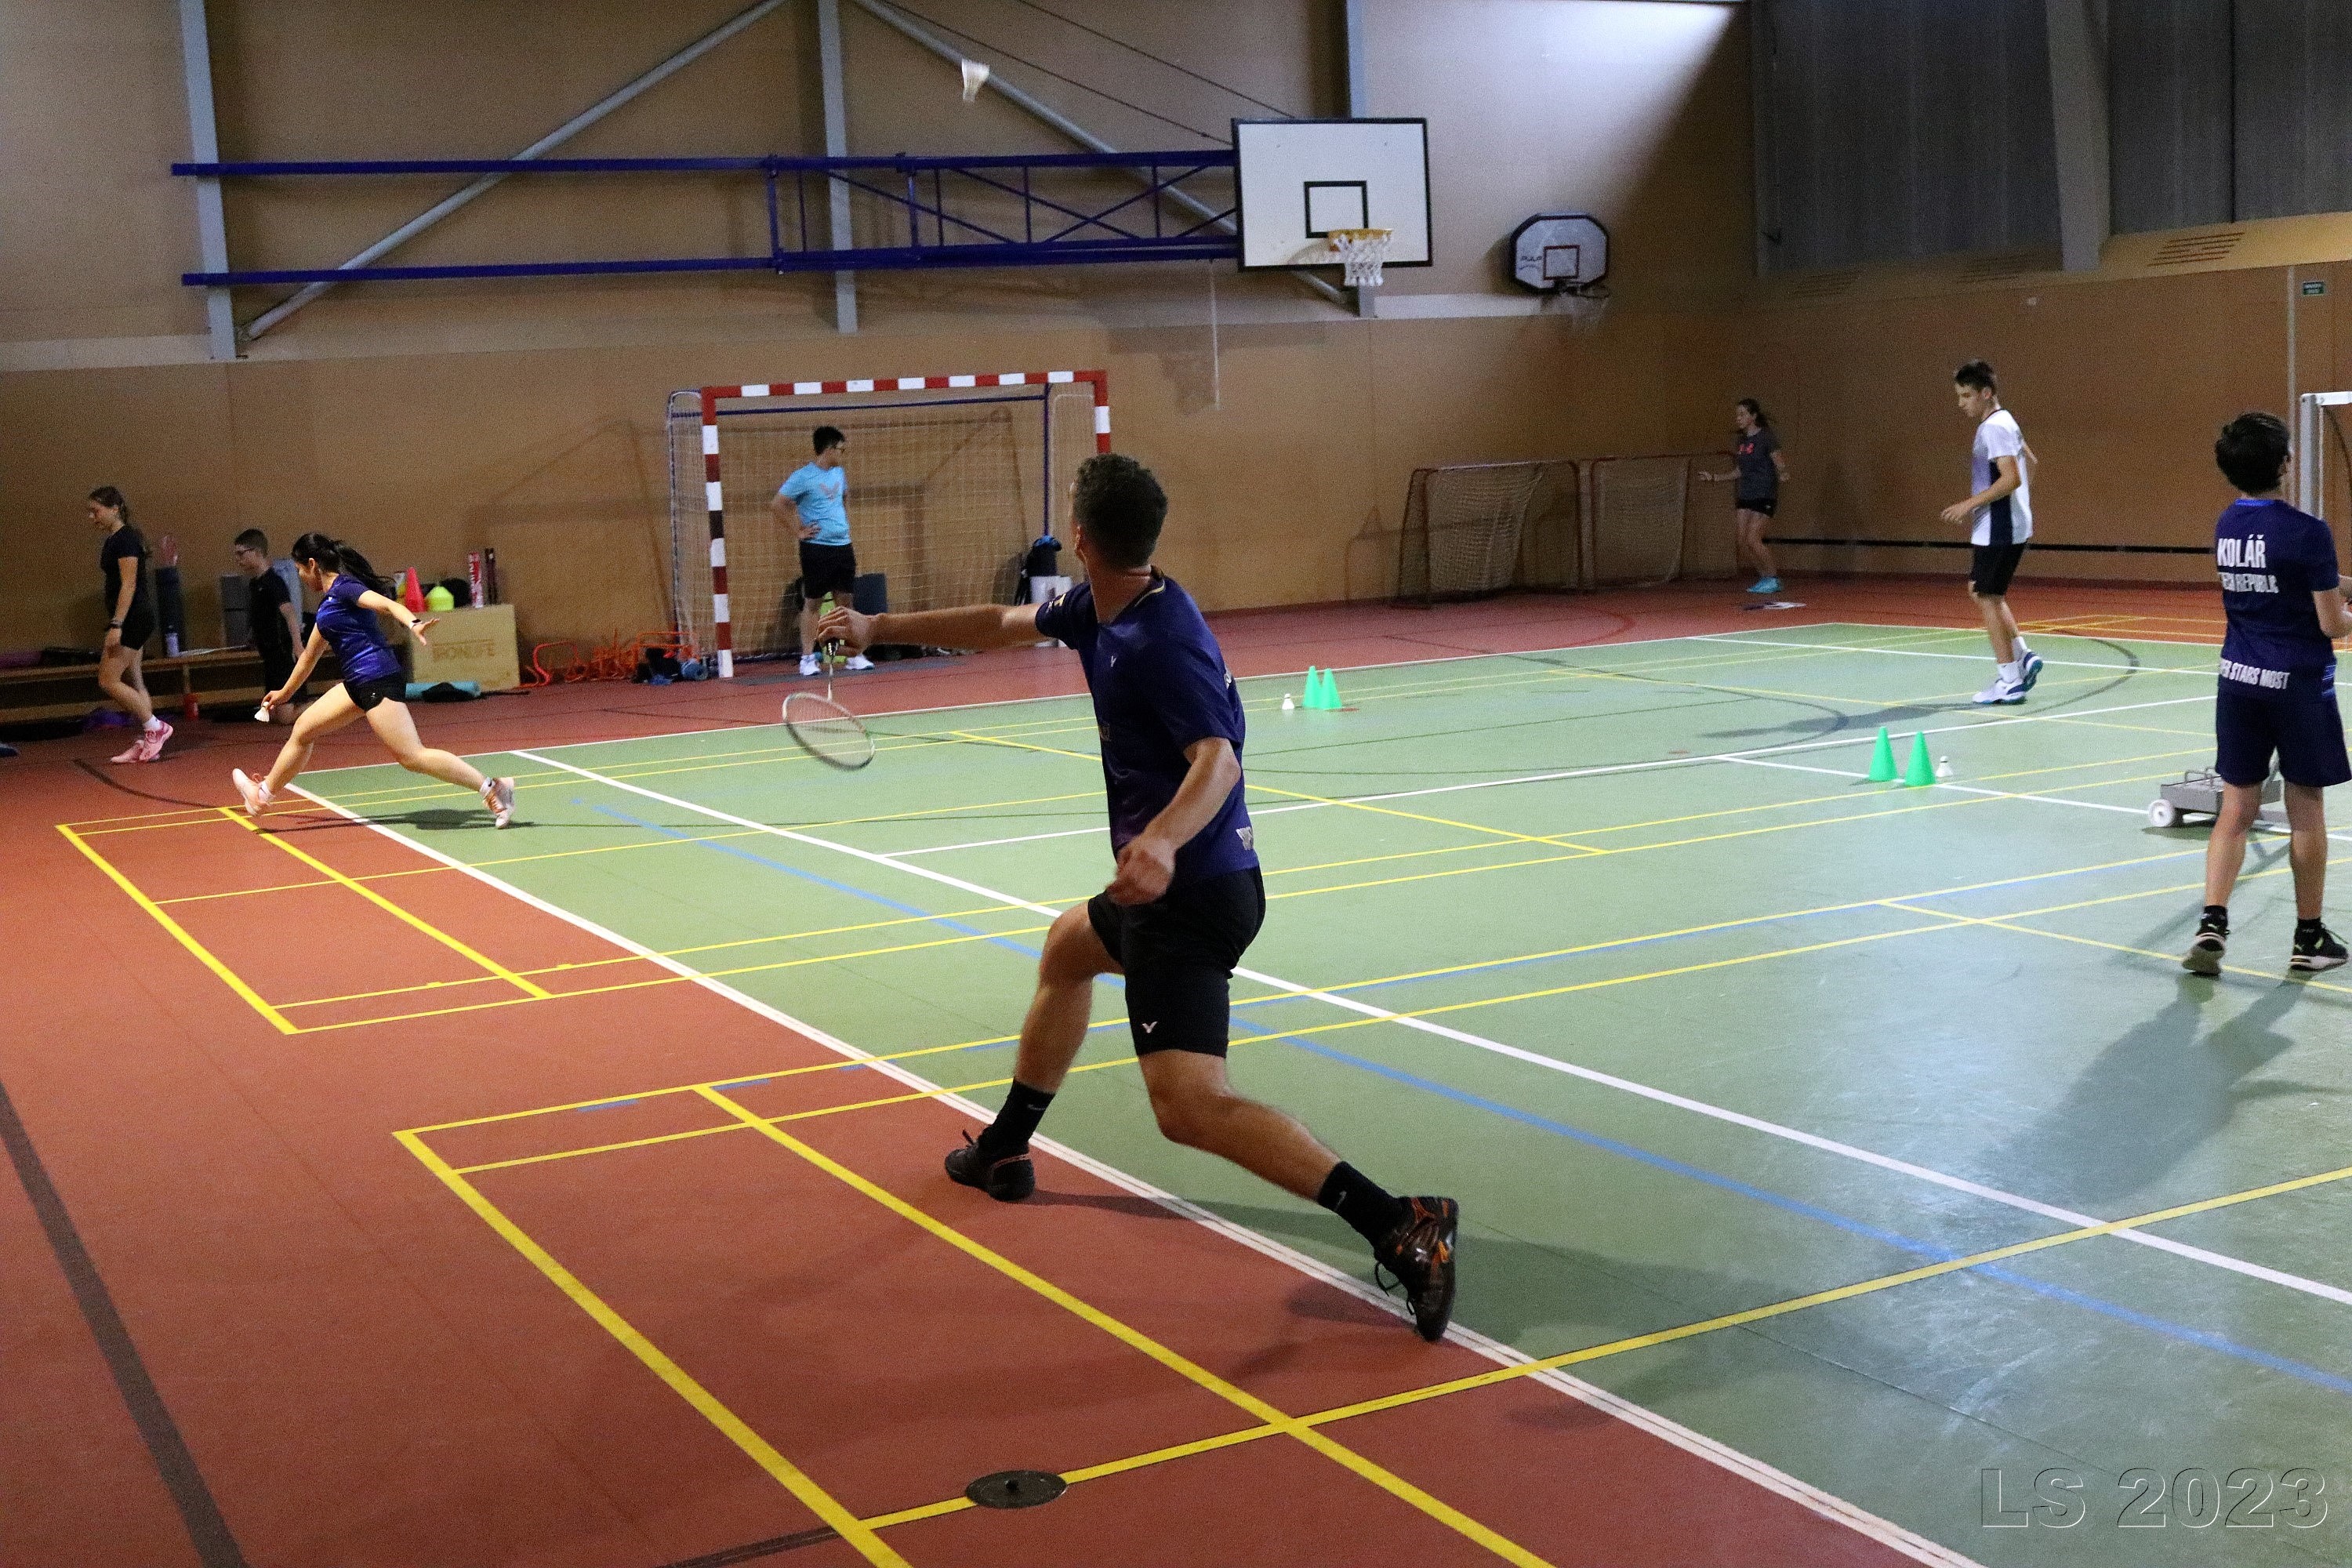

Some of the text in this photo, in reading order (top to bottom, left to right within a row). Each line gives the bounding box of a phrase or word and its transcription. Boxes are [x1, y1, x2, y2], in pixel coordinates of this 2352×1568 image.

[2217, 534, 2266, 568] KOLÁŘ
[2229, 662, 2261, 685] STARS
[2259, 669, 2291, 689] MOST
